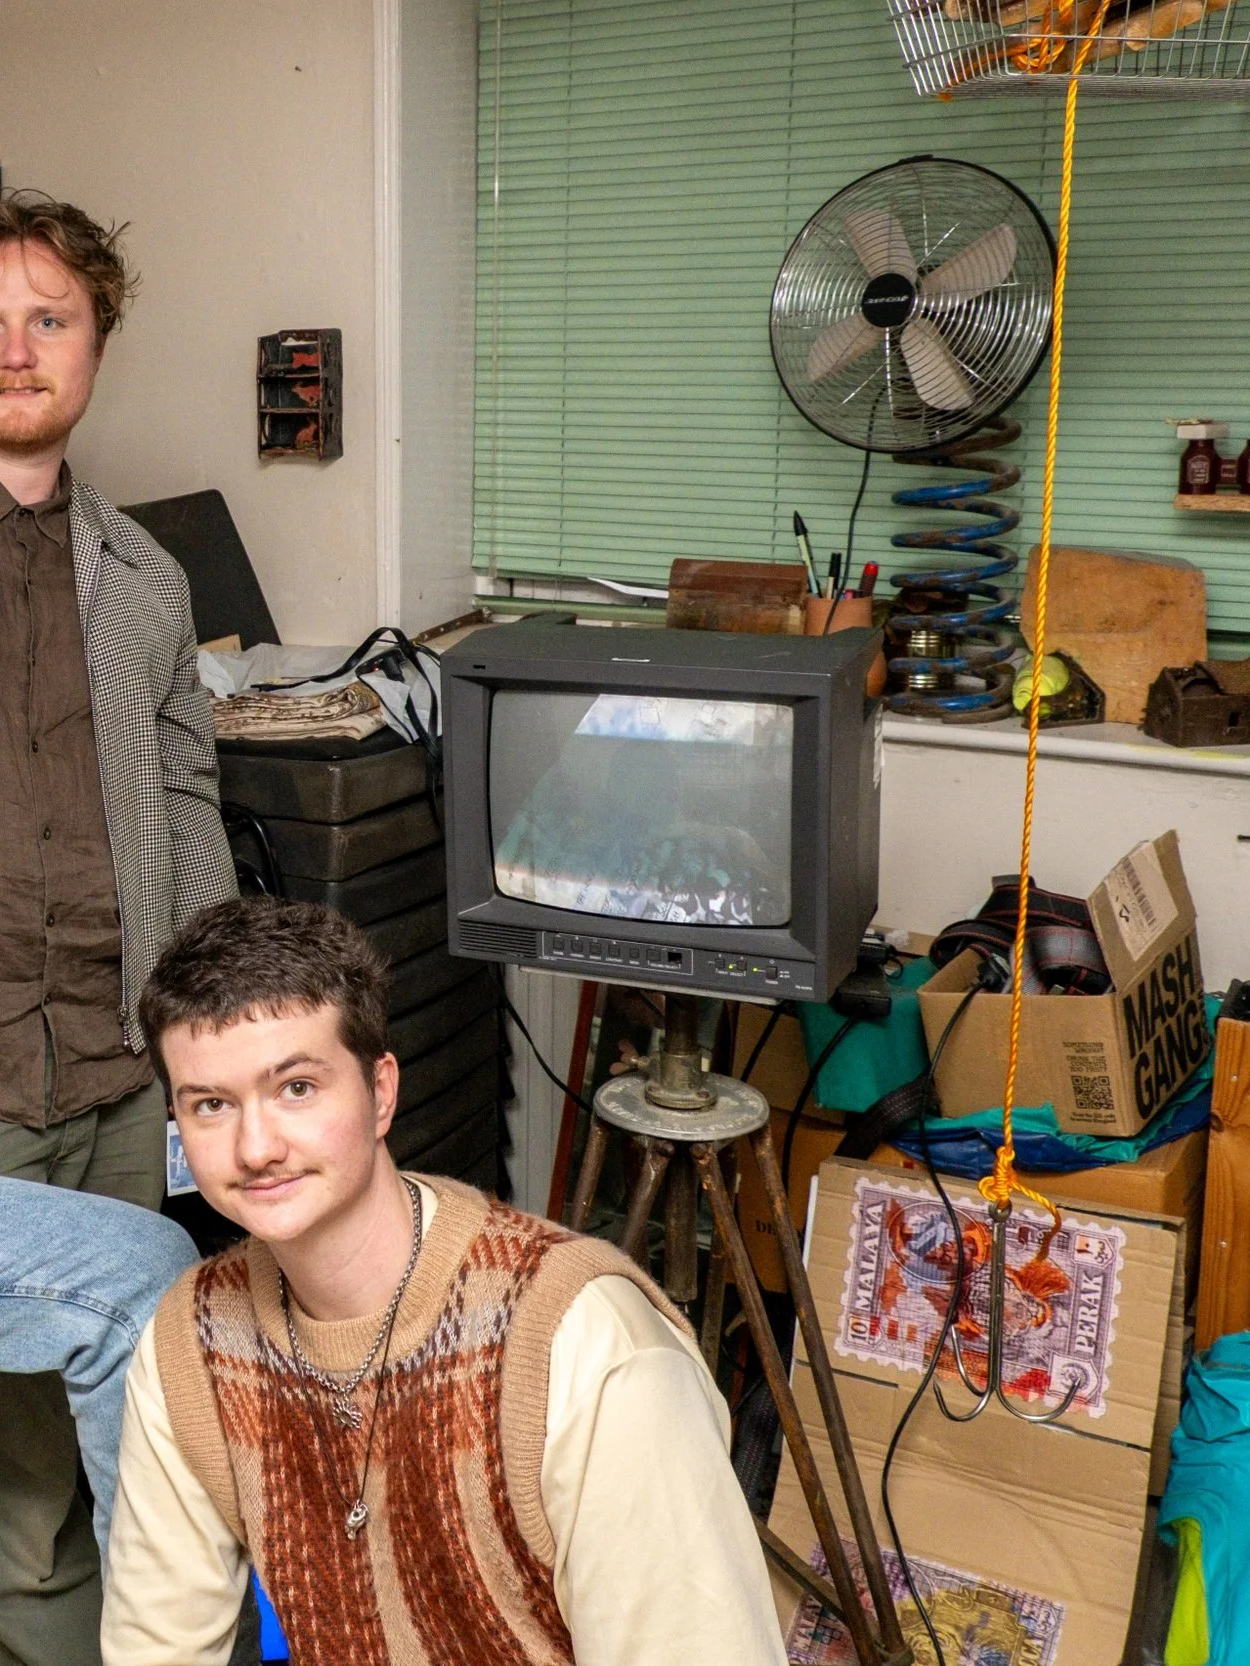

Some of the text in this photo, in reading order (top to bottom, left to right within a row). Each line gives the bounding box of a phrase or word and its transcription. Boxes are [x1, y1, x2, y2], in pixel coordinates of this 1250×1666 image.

[1122, 934, 1196, 1060] MASH
[1134, 999, 1203, 1120] GANG
[856, 1200, 885, 1312] MALAYA
[851, 1321, 868, 1342] 10
[1075, 1271, 1103, 1356] PERAK
